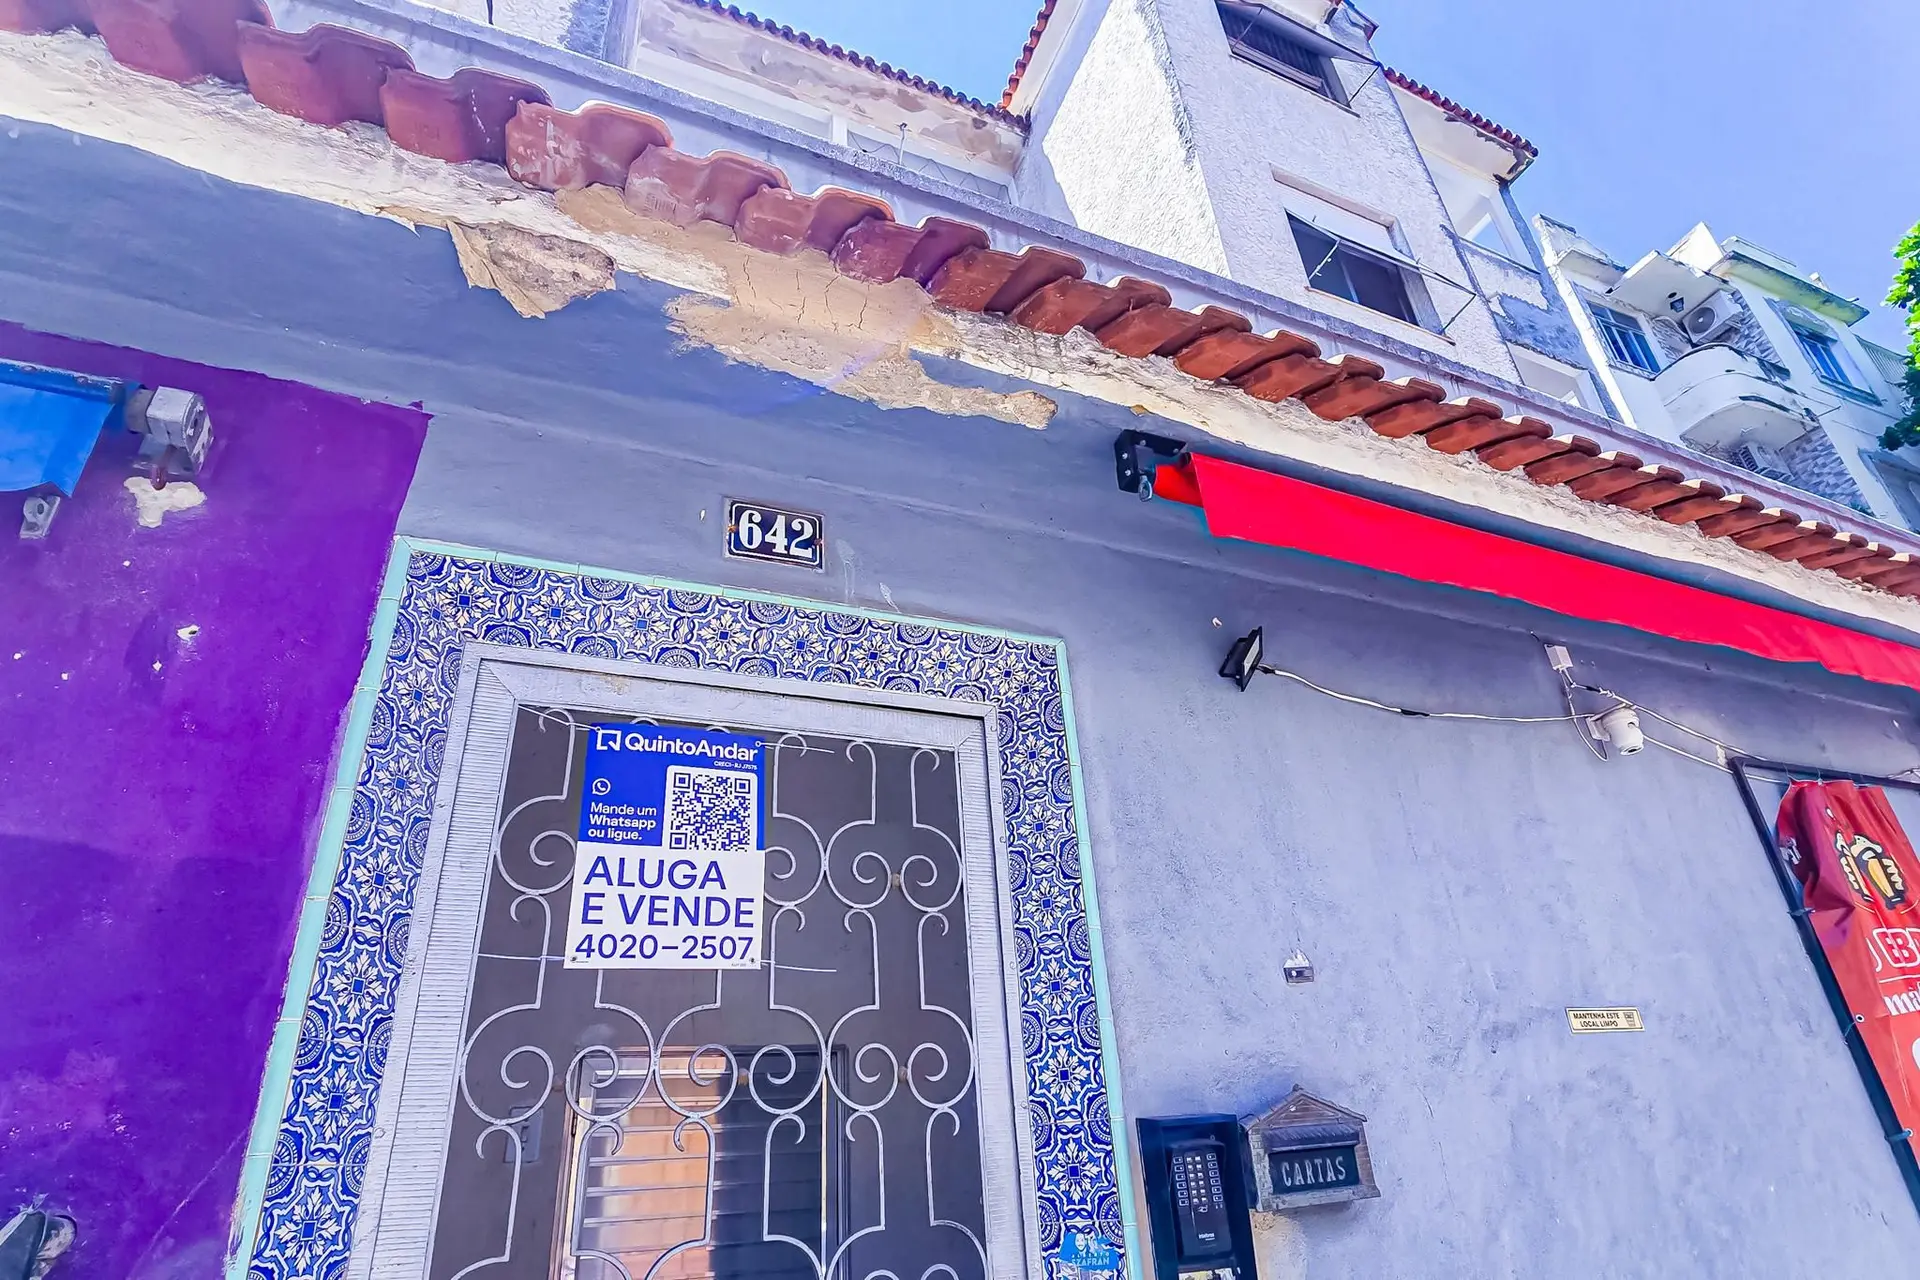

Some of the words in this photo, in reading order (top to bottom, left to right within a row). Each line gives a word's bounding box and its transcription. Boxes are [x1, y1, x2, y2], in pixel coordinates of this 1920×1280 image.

[738, 509, 814, 559] 642
[624, 732, 759, 762] QuintoAndar
[589, 813, 657, 831] Whatsapp
[590, 801, 635, 815] Mande
[637, 806, 657, 816] um
[587, 828, 605, 838] ou
[607, 827, 643, 841] ligue.
[582, 855, 727, 890] ALUGA
[581, 892, 606, 925] E
[617, 893, 755, 928] VENDE
[575, 933, 754, 960] 4020-2507
[1572, 1012, 1606, 1020] MANTENHA
[1606, 1012, 1620, 1020] ESTE
[1579, 1020, 1599, 1028] LOCAL
[1599, 1020, 1619, 1028] LIMPO
[1281, 1155, 1346, 1187] CARTAS
